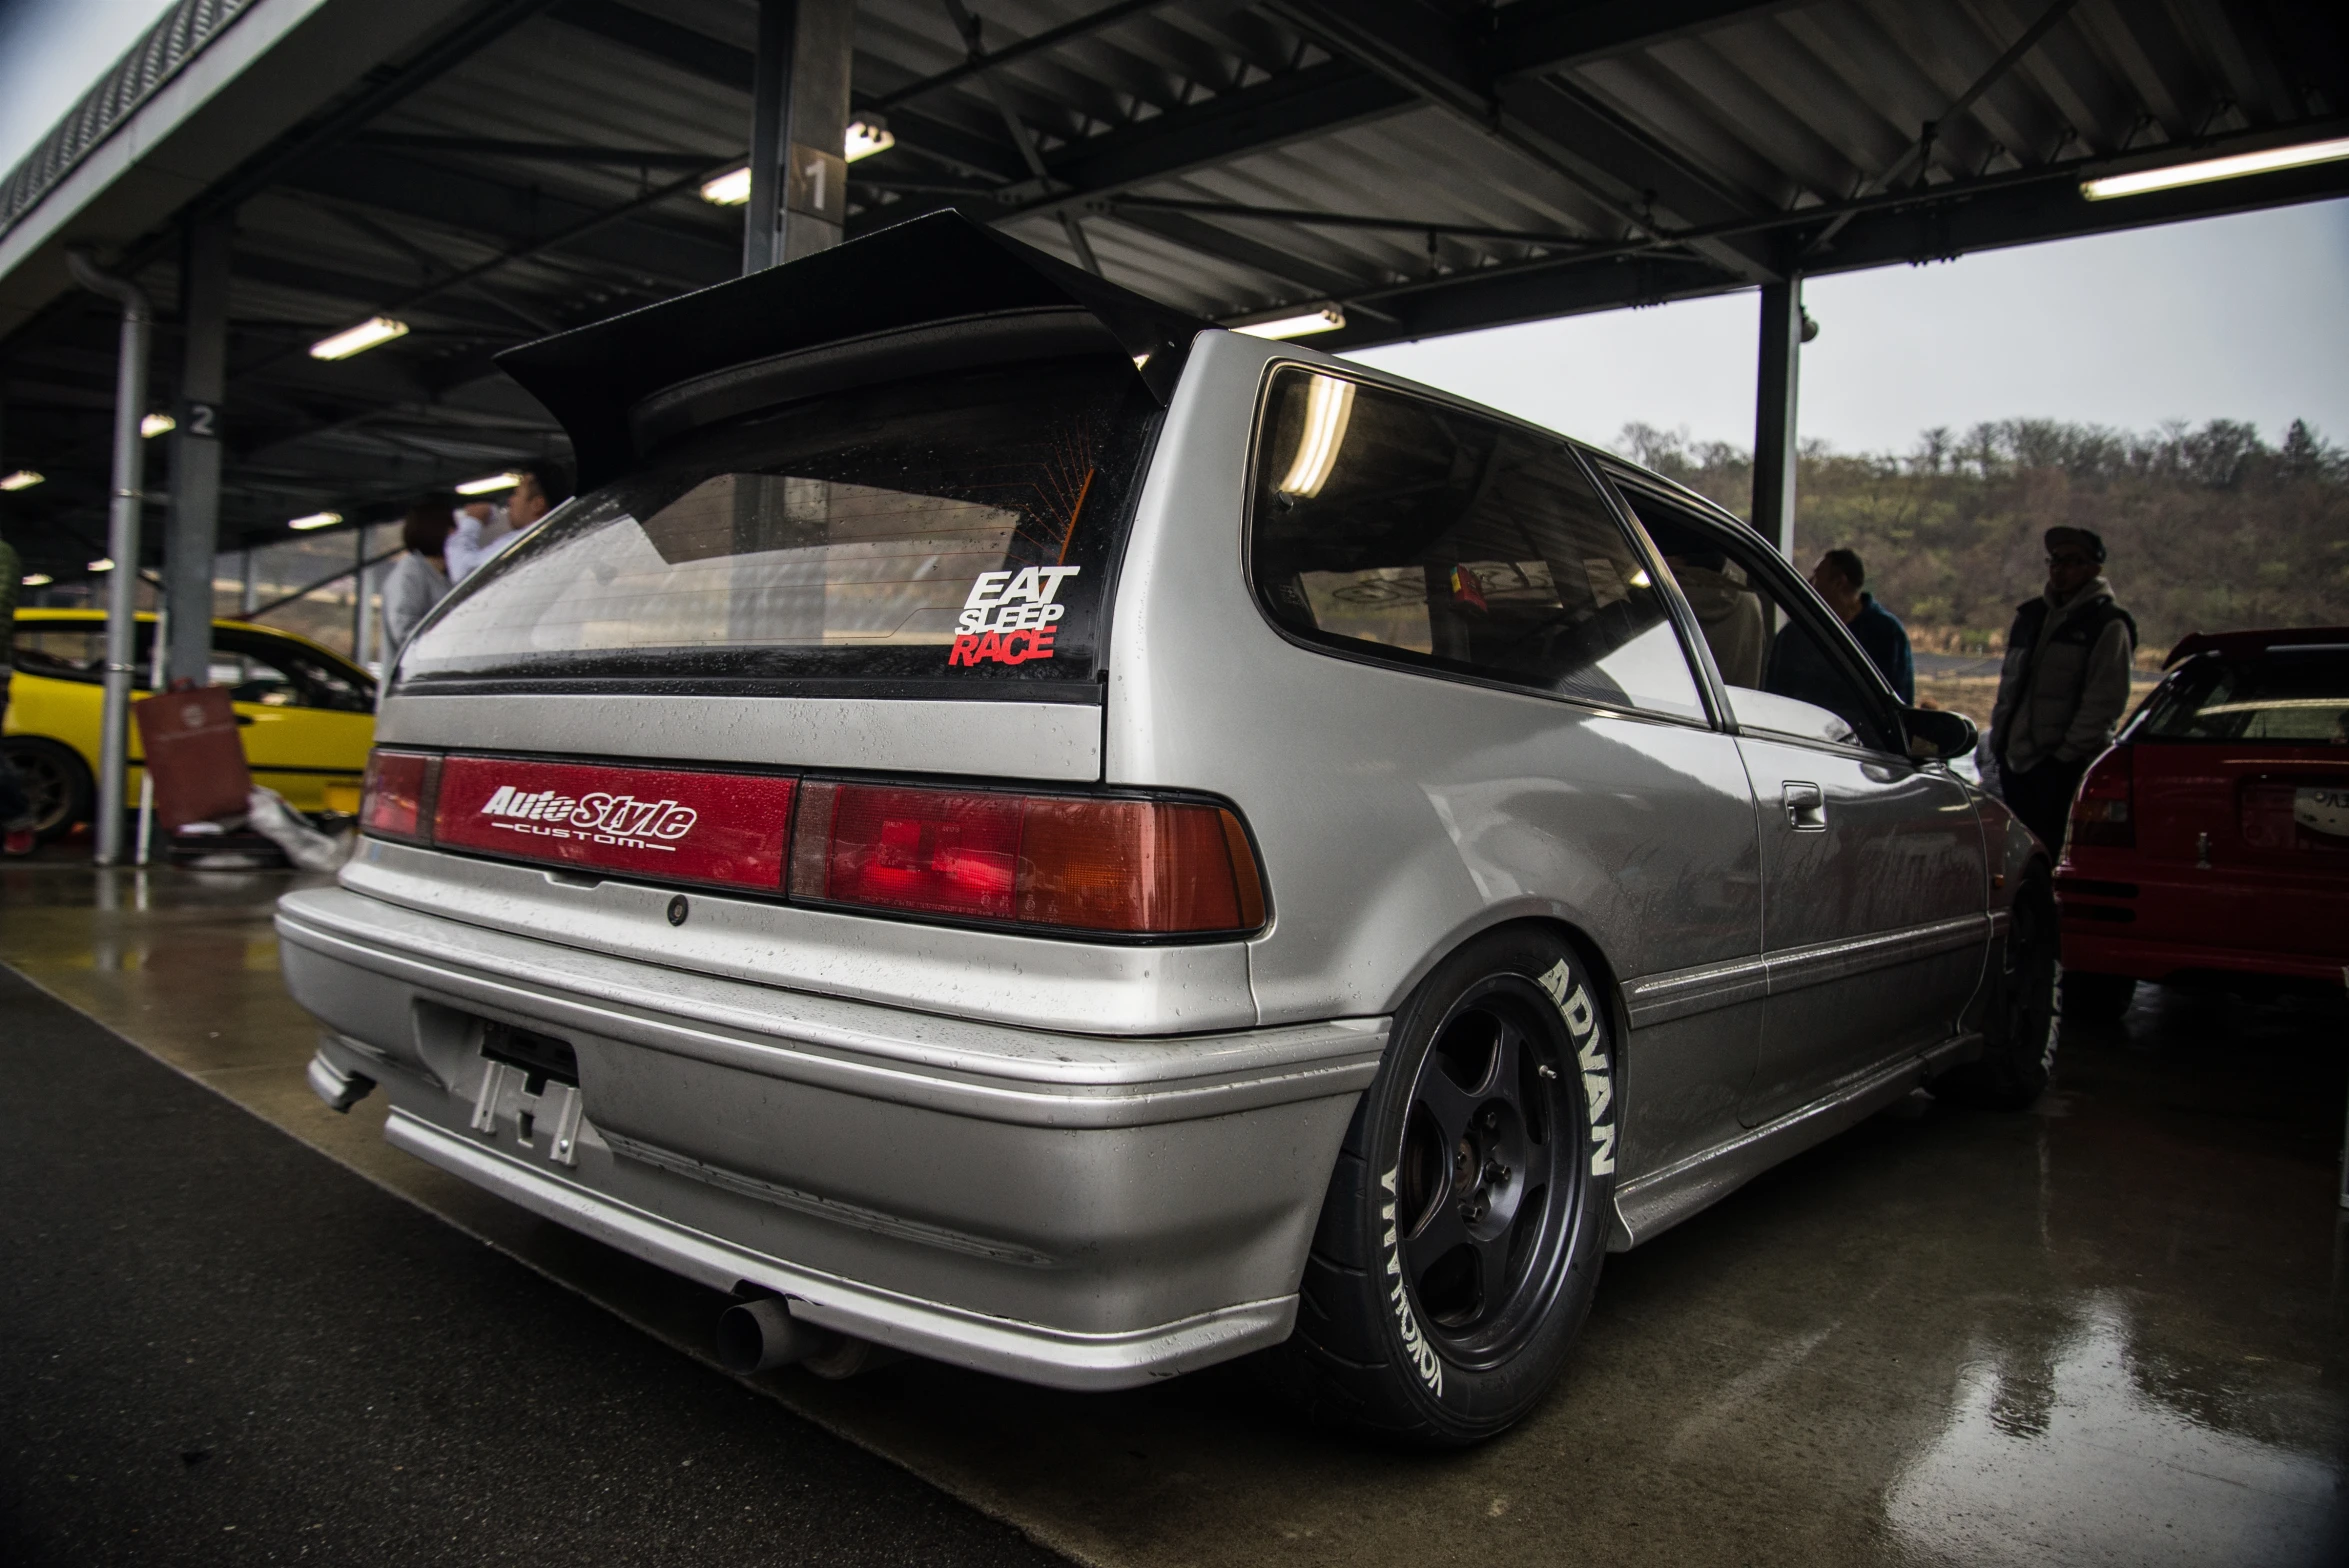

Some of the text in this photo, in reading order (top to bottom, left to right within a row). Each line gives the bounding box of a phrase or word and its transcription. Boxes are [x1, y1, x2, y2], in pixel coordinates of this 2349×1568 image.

[805, 159, 825, 210] 1
[191, 404, 214, 436] 2
[963, 566, 1081, 609] EAT
[954, 603, 1065, 635] SLEEP
[948, 625, 1058, 667] RACE
[513, 822, 646, 849] CUSTOM
[1538, 957, 1615, 1177] ADVAN
[1381, 1164, 1442, 1398] YOKOHAMA
